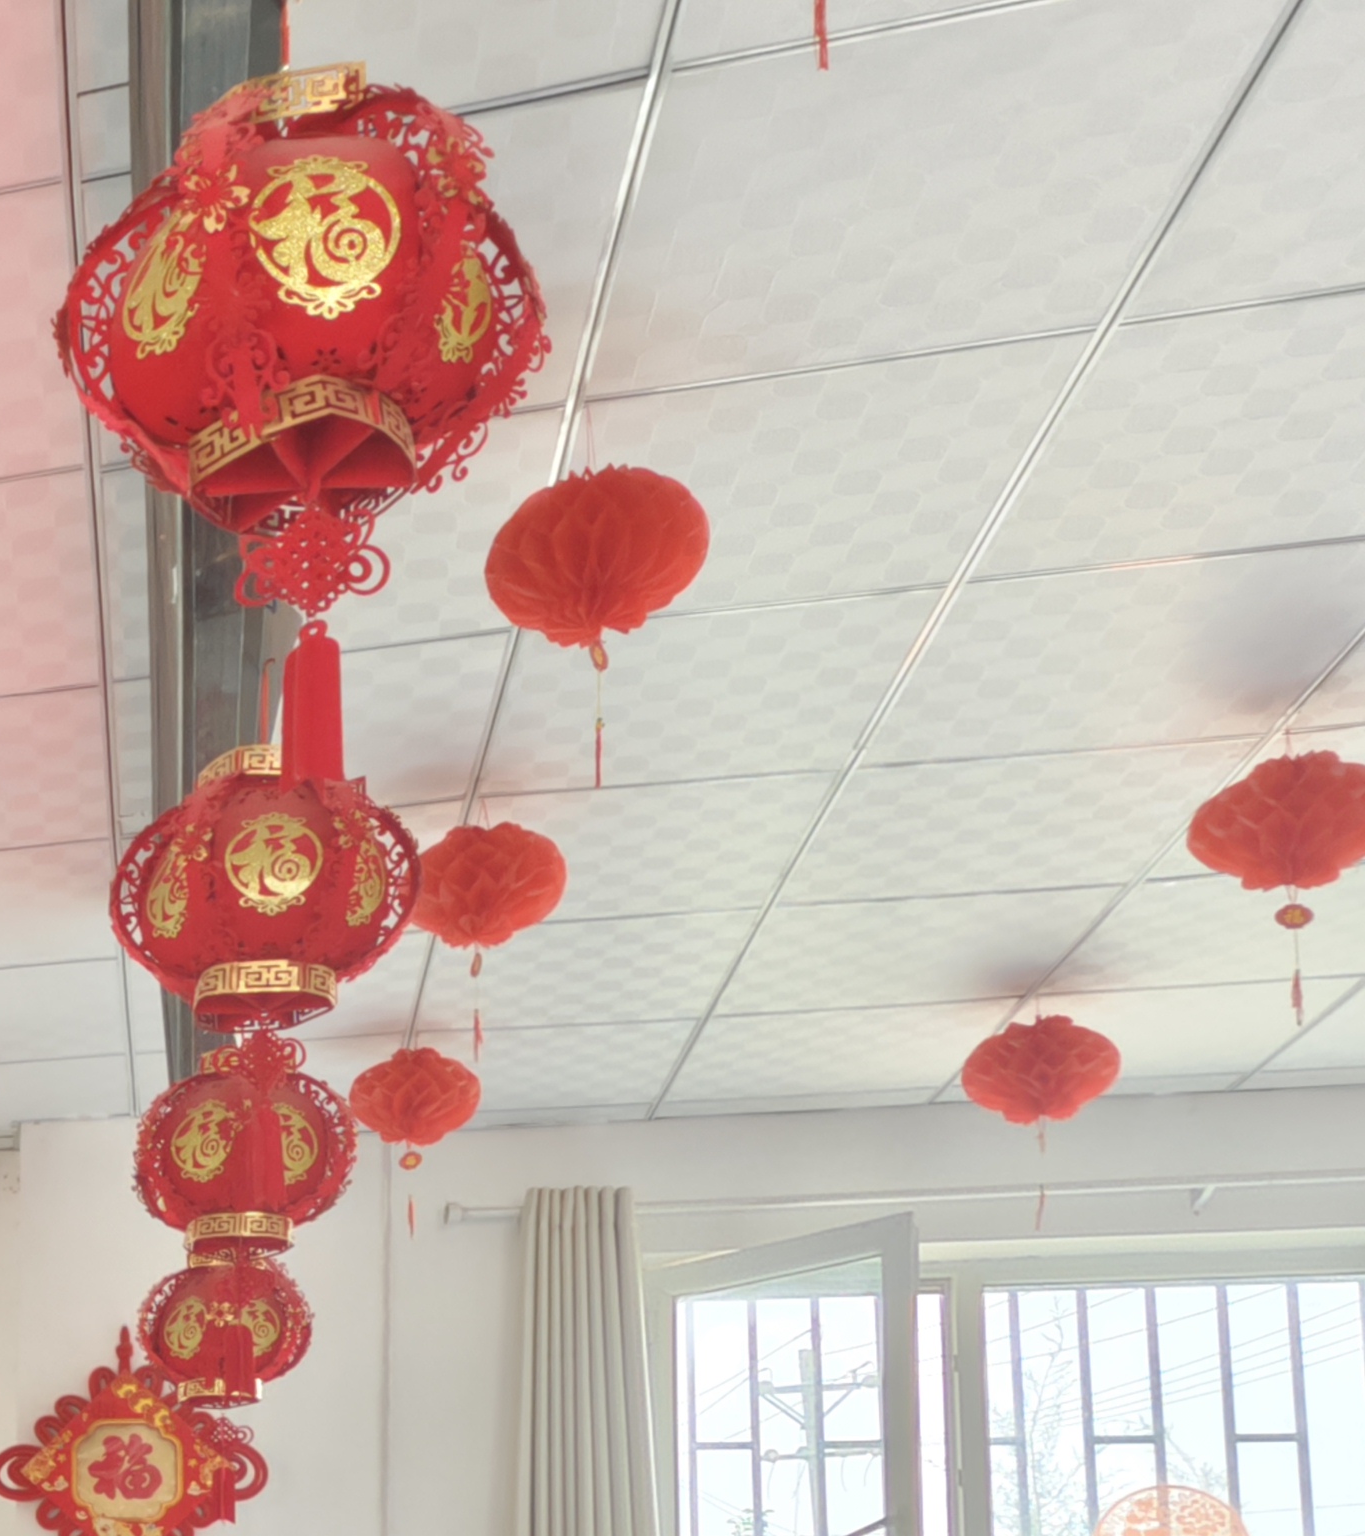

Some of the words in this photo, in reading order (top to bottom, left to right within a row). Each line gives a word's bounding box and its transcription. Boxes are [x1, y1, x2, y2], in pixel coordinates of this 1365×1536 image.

[251, 162, 399, 294] 福
[228, 822, 321, 900] 福
[87, 1433, 164, 1501] 福
